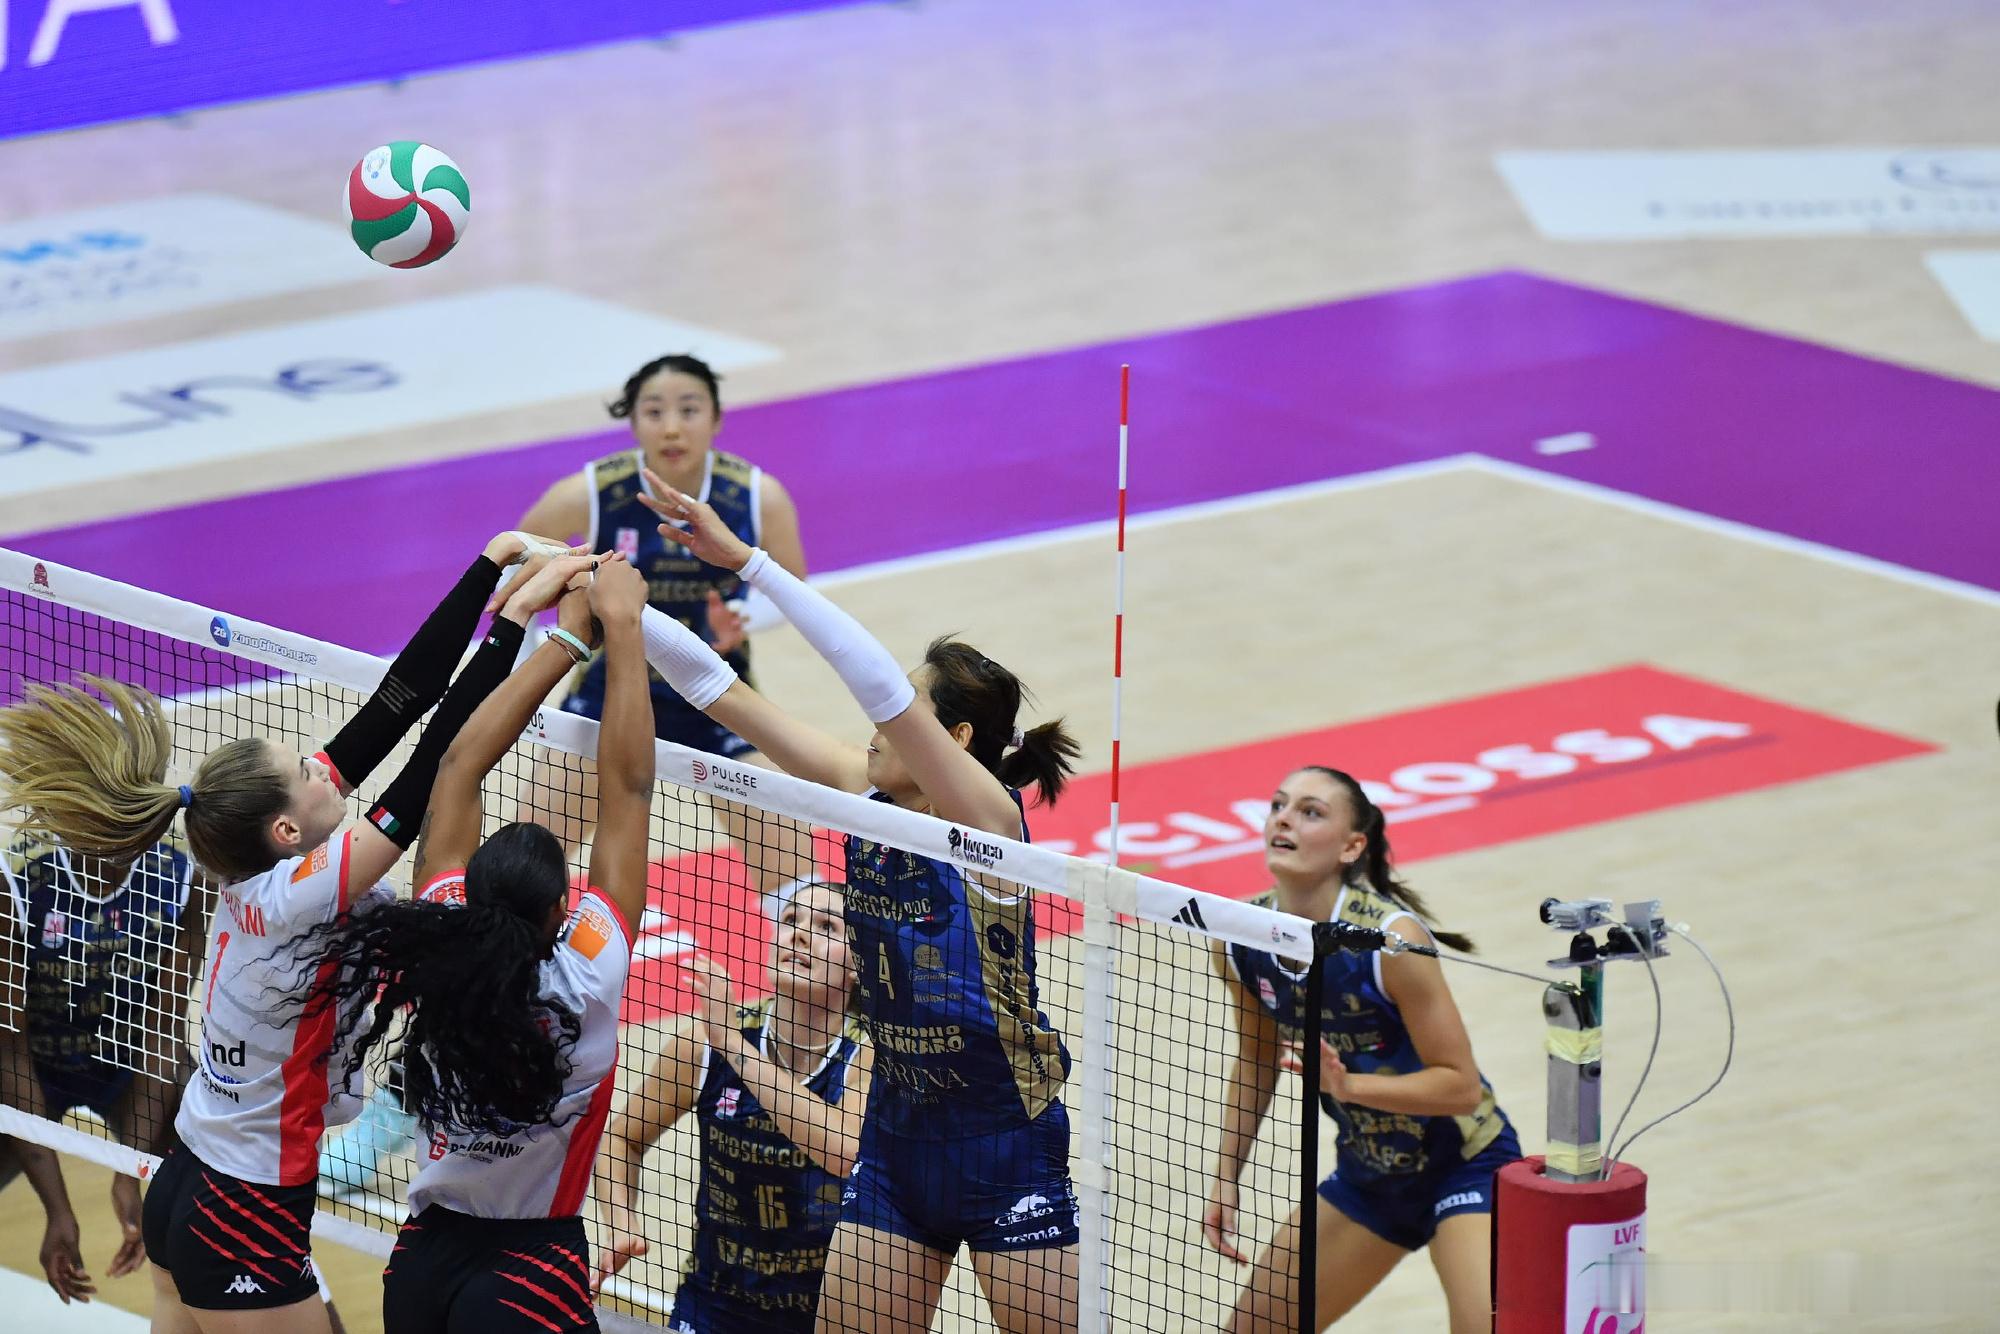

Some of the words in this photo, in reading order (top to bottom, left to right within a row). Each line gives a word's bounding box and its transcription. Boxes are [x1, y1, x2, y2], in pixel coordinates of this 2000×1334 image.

[711, 765, 757, 789] PULSEE
[207, 931, 230, 1014] 1
[878, 941, 895, 1000] 4
[709, 1125, 808, 1168] PROSECCO
[1614, 1223, 1640, 1246] LVF
